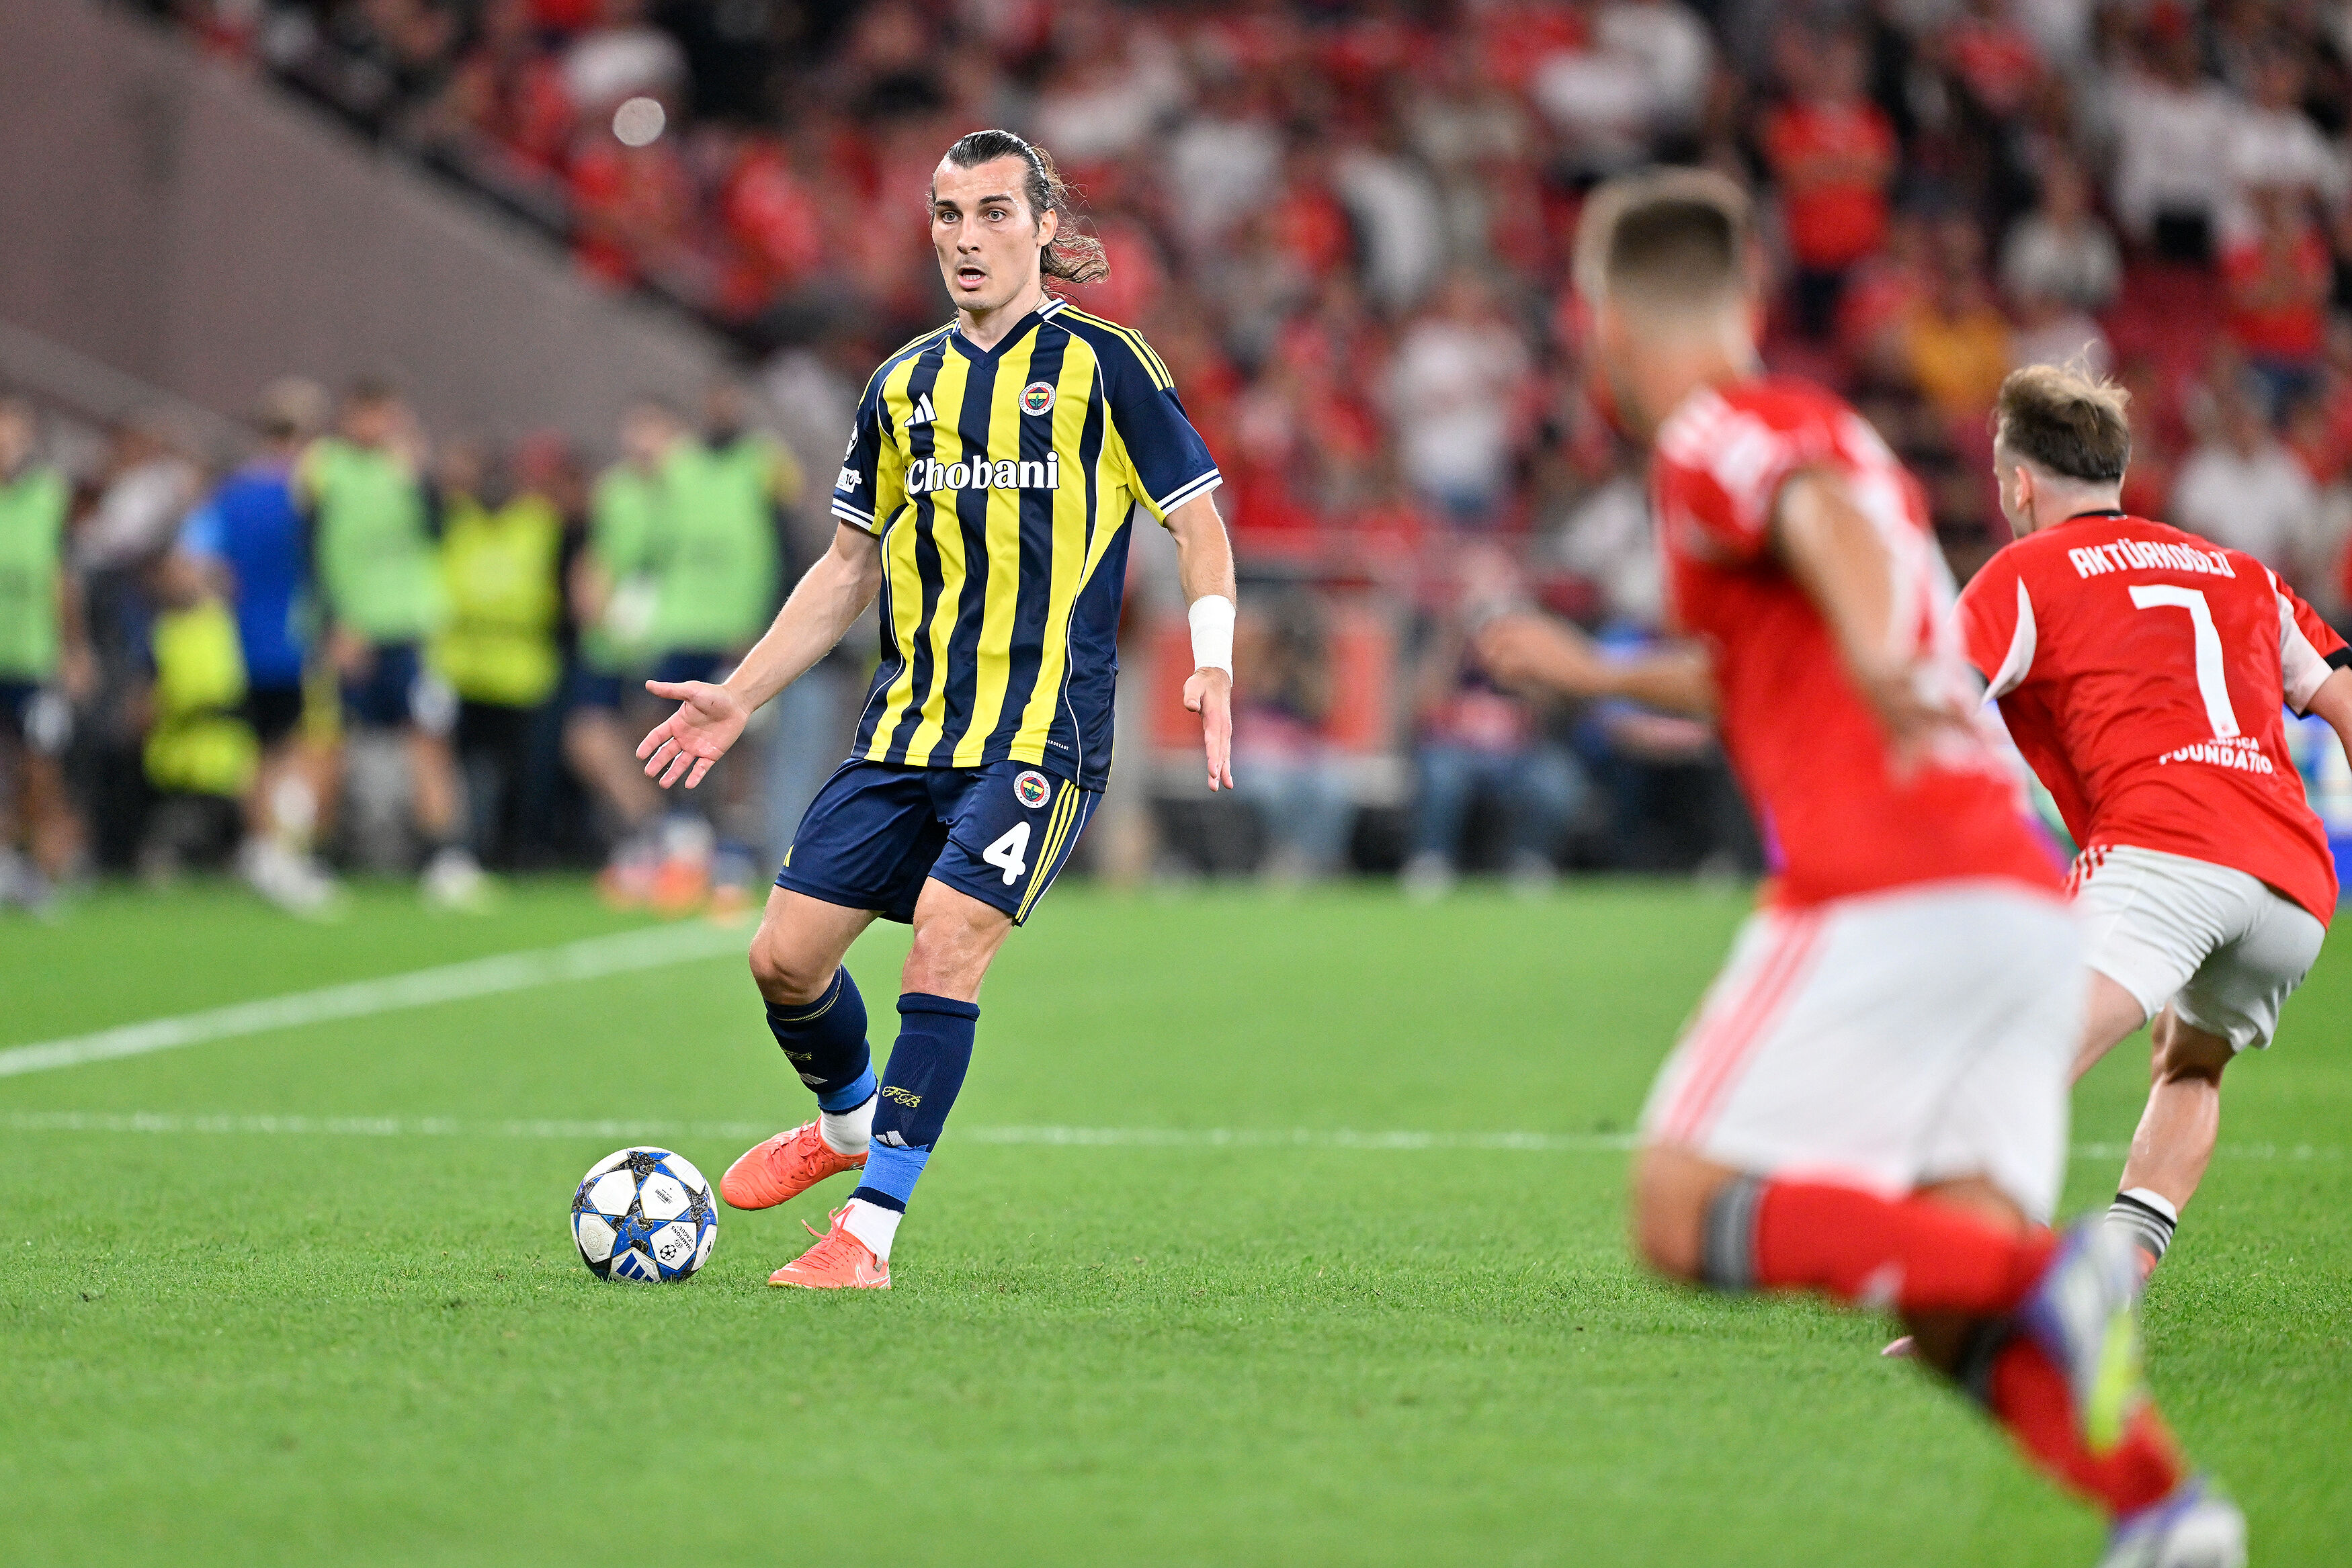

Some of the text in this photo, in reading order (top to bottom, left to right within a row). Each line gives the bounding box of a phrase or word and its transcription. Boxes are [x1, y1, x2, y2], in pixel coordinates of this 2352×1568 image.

[907, 451, 1060, 495] Chobani
[2128, 584, 2241, 738] 7
[982, 821, 1032, 886] 4
